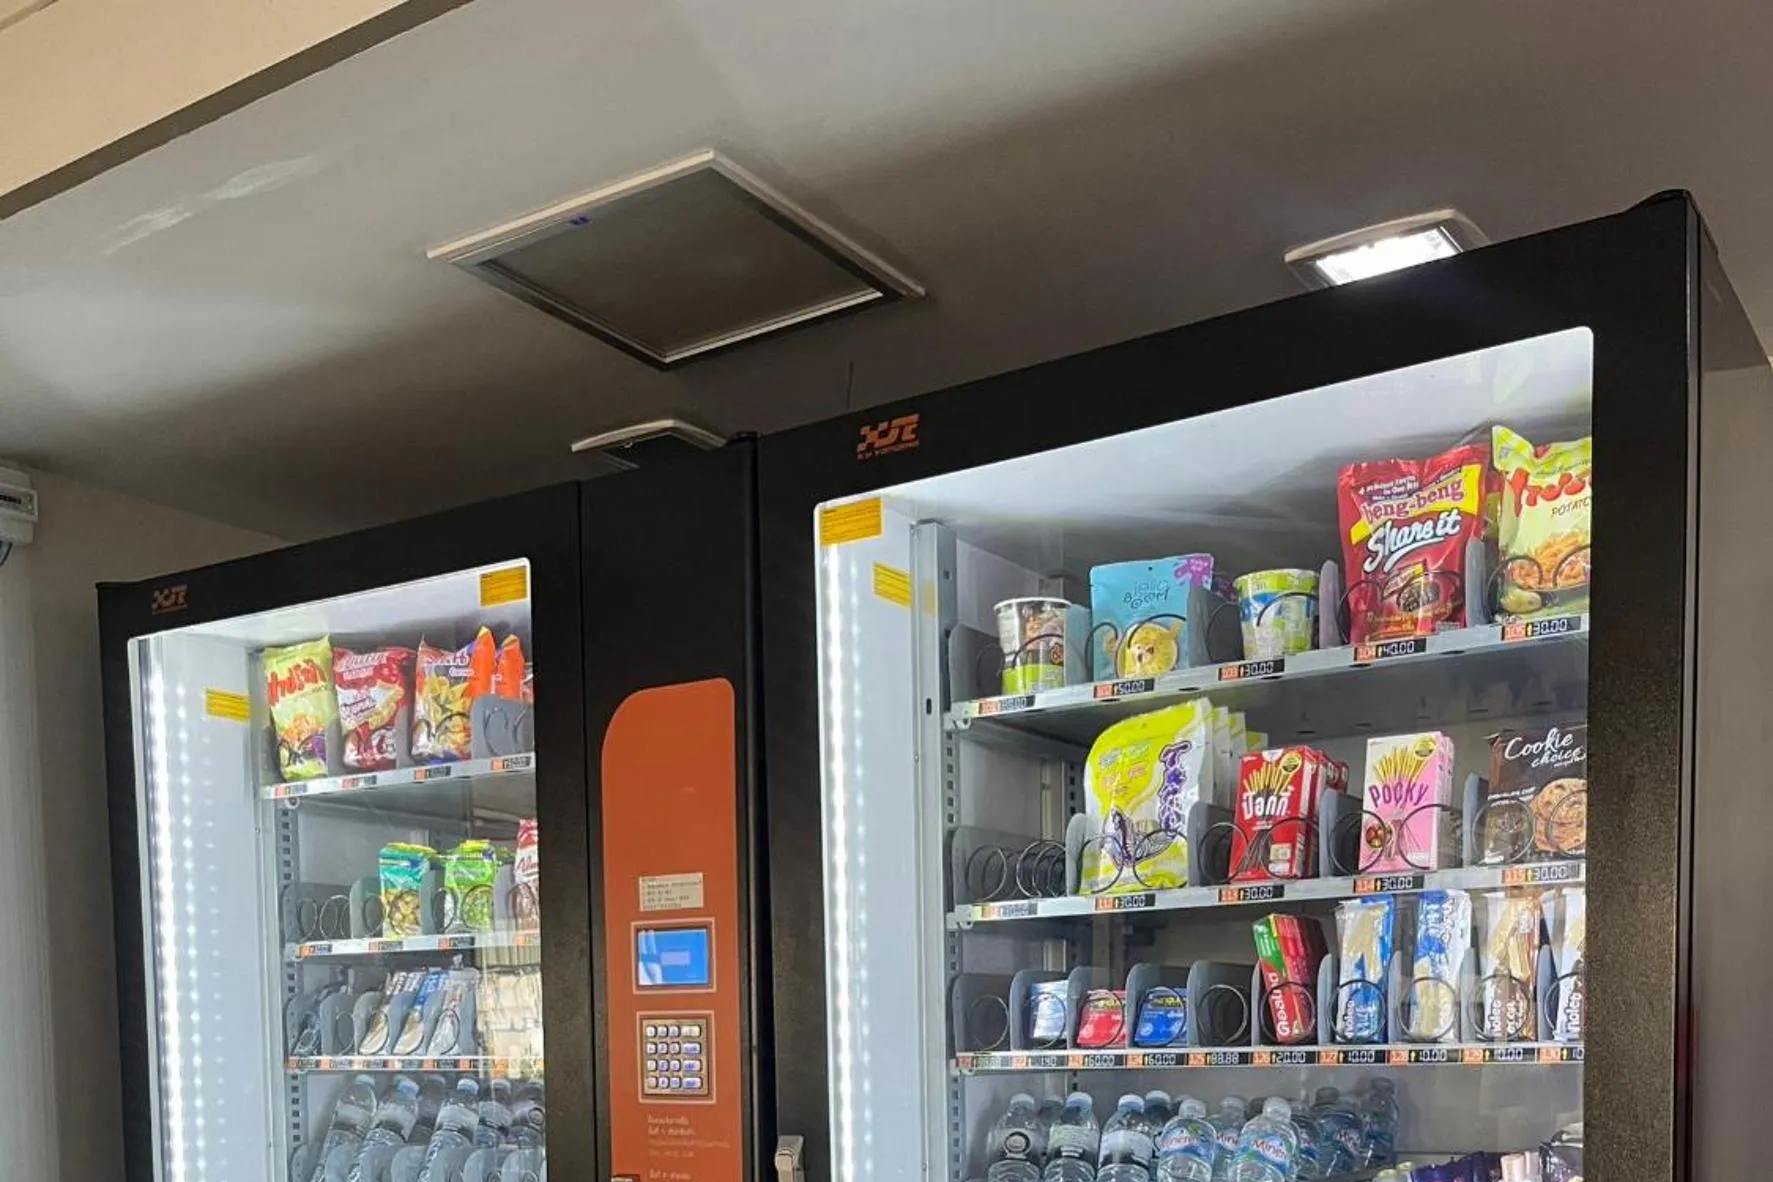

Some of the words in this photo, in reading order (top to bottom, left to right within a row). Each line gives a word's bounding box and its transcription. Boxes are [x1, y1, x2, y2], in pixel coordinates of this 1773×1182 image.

[1363, 519, 1434, 573] Share
[1436, 508, 1462, 537] it
[1534, 618, 1567, 635] 30.00
[1504, 727, 1574, 761] Cookie
[1368, 781, 1429, 809] POCKY
[1381, 877, 1412, 890] 30.00
